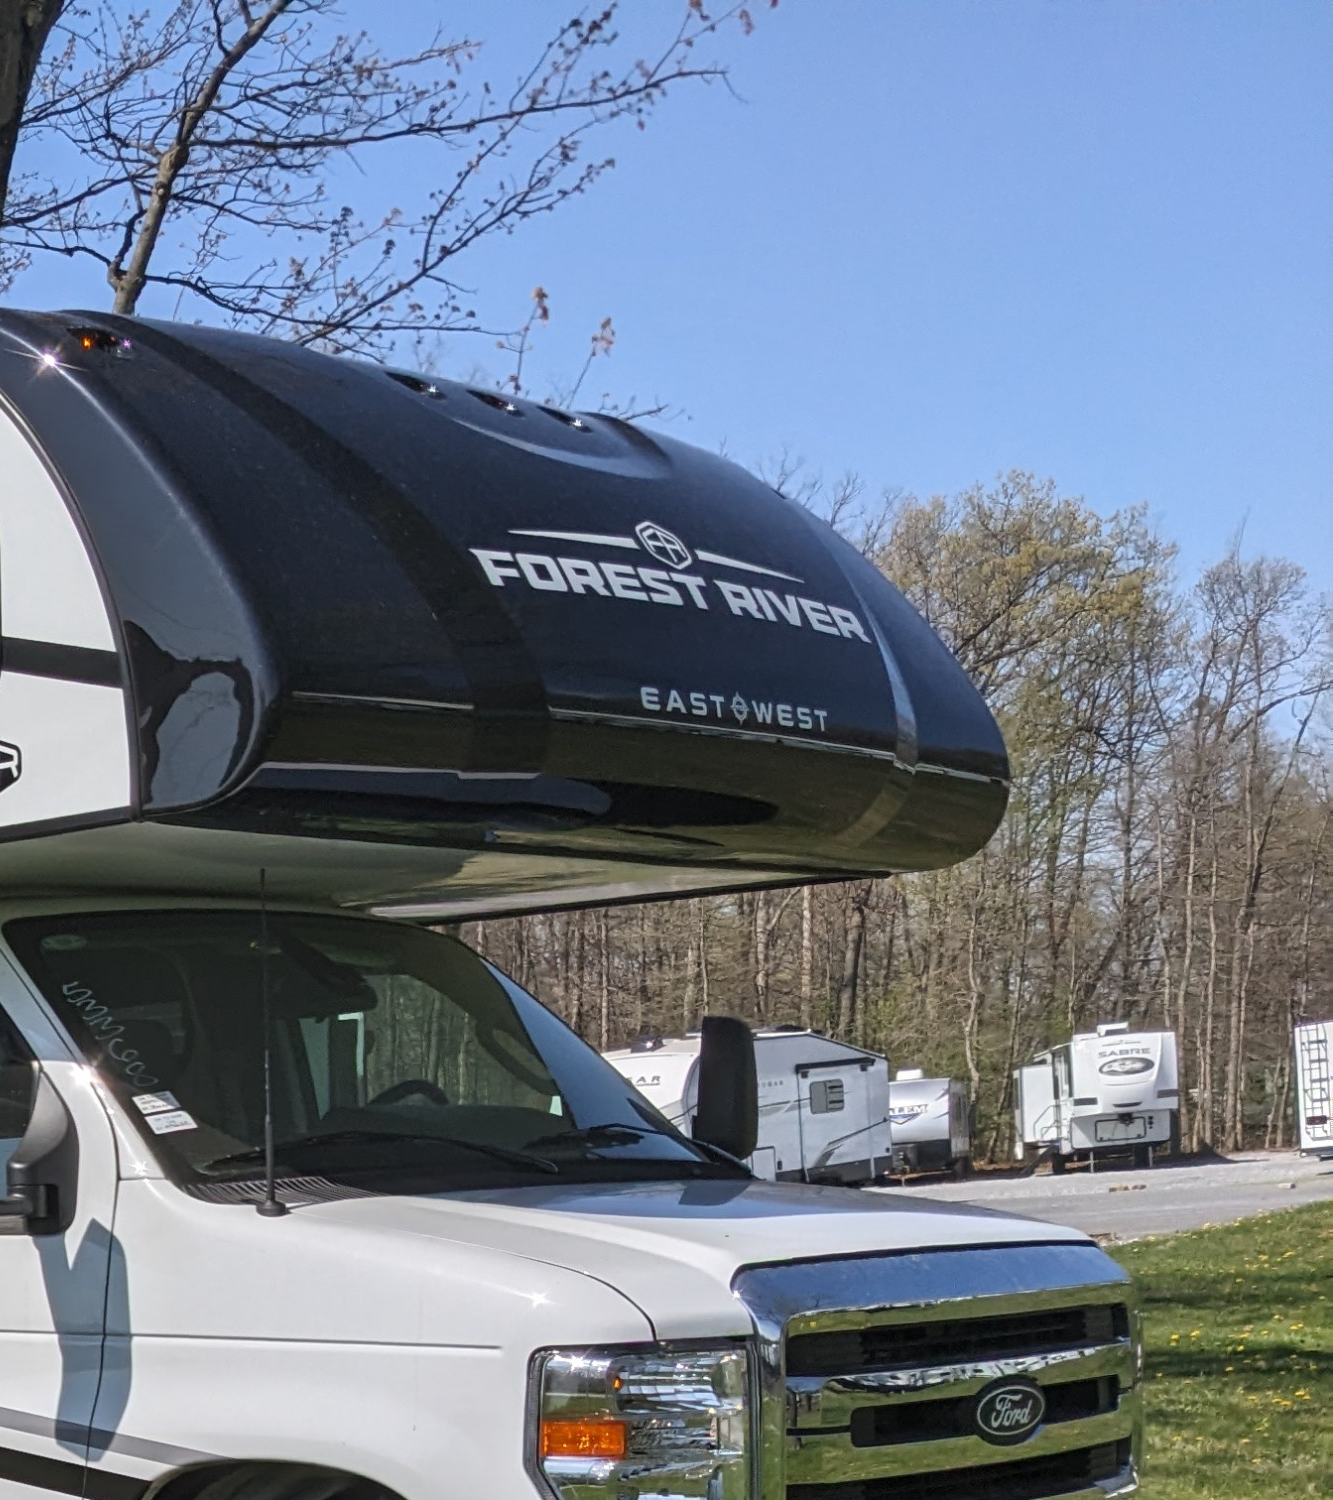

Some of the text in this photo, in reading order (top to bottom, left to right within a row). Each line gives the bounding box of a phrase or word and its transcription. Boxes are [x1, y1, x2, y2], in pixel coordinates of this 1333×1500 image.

[469, 547, 873, 644] FOREST RIVER
[640, 686, 727, 719] EAST
[752, 701, 828, 733] WEST
[1098, 1047, 1152, 1058] SABRE
[889, 1103, 929, 1115] LEM
[990, 1393, 1033, 1429] Ford
